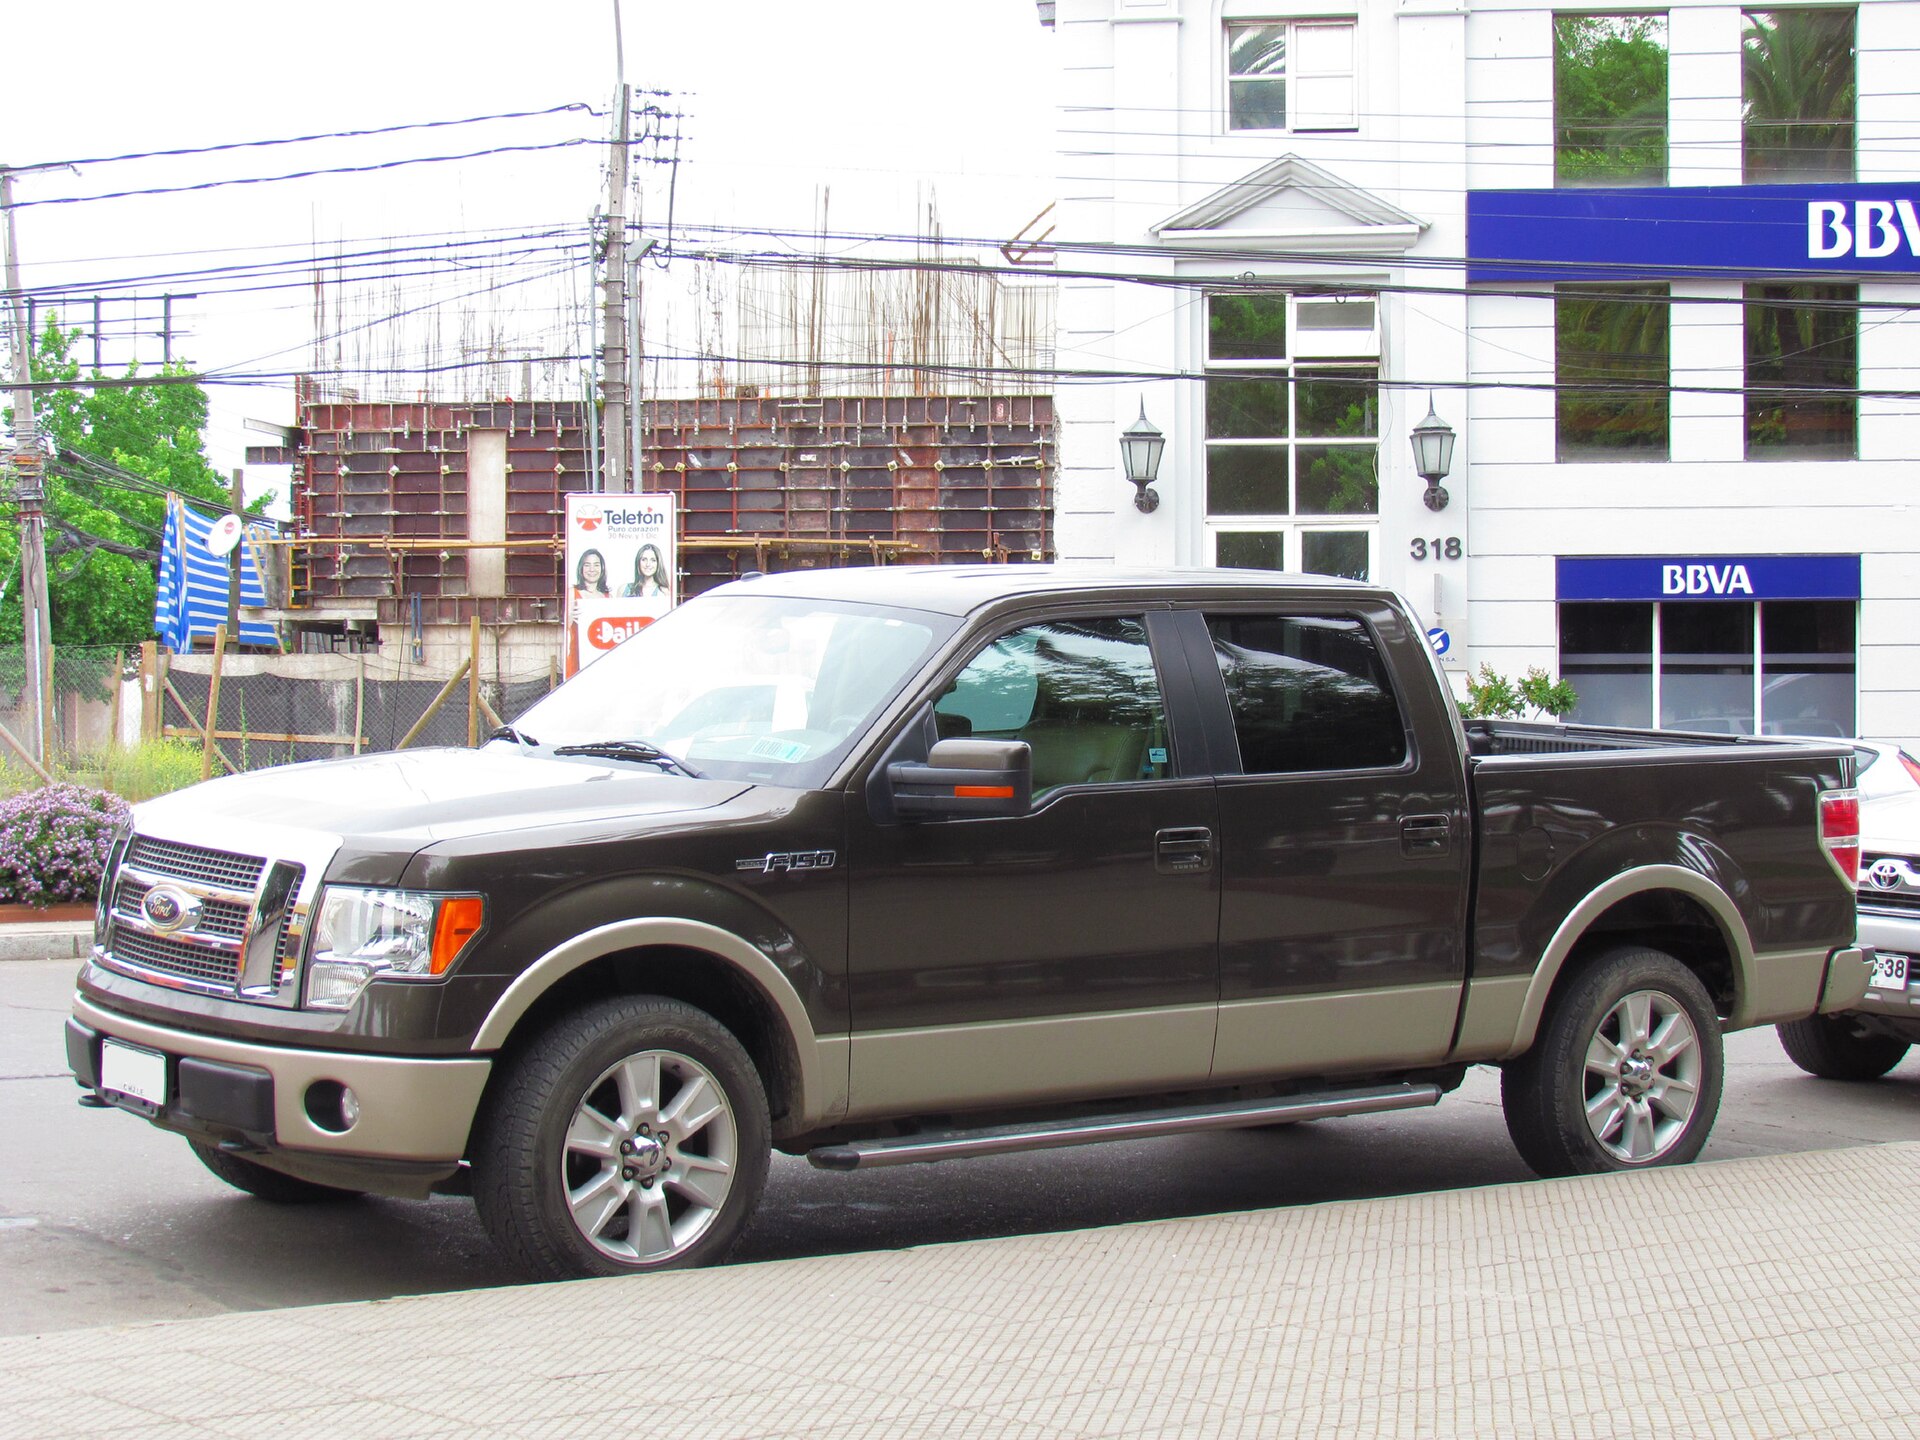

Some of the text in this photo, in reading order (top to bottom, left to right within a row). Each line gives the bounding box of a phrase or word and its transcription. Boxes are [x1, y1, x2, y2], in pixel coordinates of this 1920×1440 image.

[1807, 200, 1920, 258] BBV
[1410, 536, 1462, 561] 318
[1662, 565, 1753, 594] BBVA
[597, 621, 644, 643] Dail
[150, 895, 173, 917] Ford
